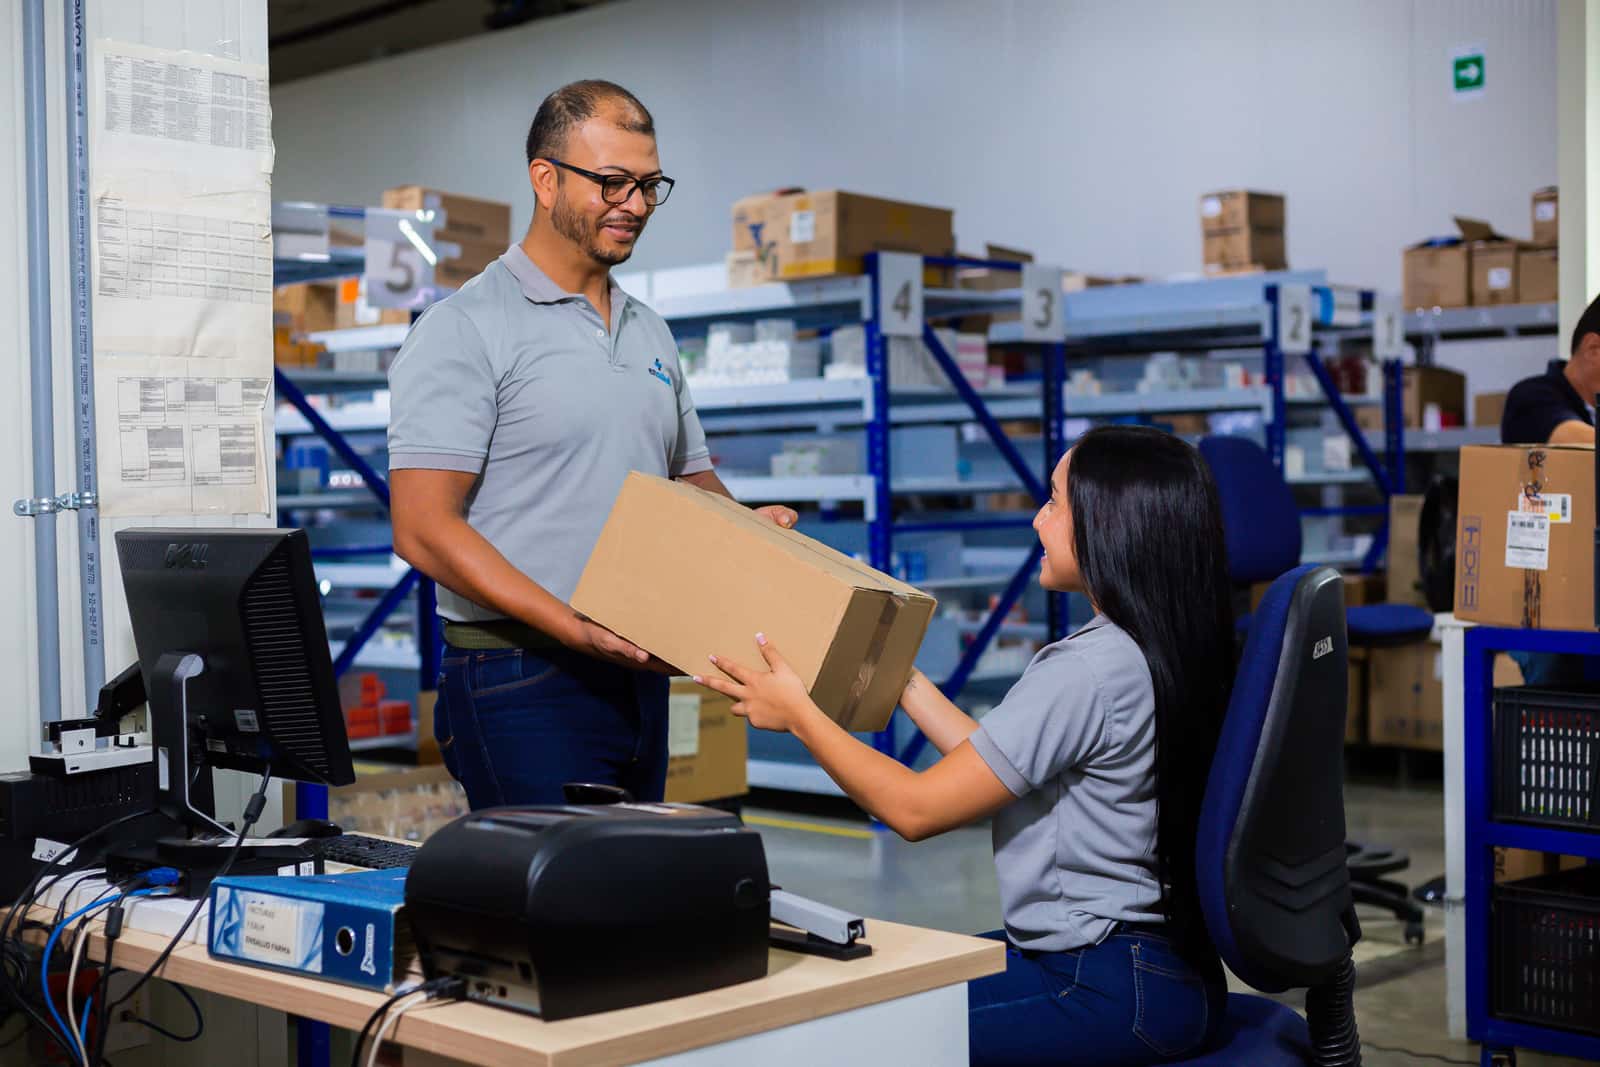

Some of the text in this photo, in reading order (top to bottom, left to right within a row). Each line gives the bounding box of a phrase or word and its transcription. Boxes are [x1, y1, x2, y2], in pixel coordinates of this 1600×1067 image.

[384, 240, 414, 294] 5
[892, 279, 912, 321] 4
[1033, 288, 1054, 329] 3
[1289, 306, 1303, 341] 2
